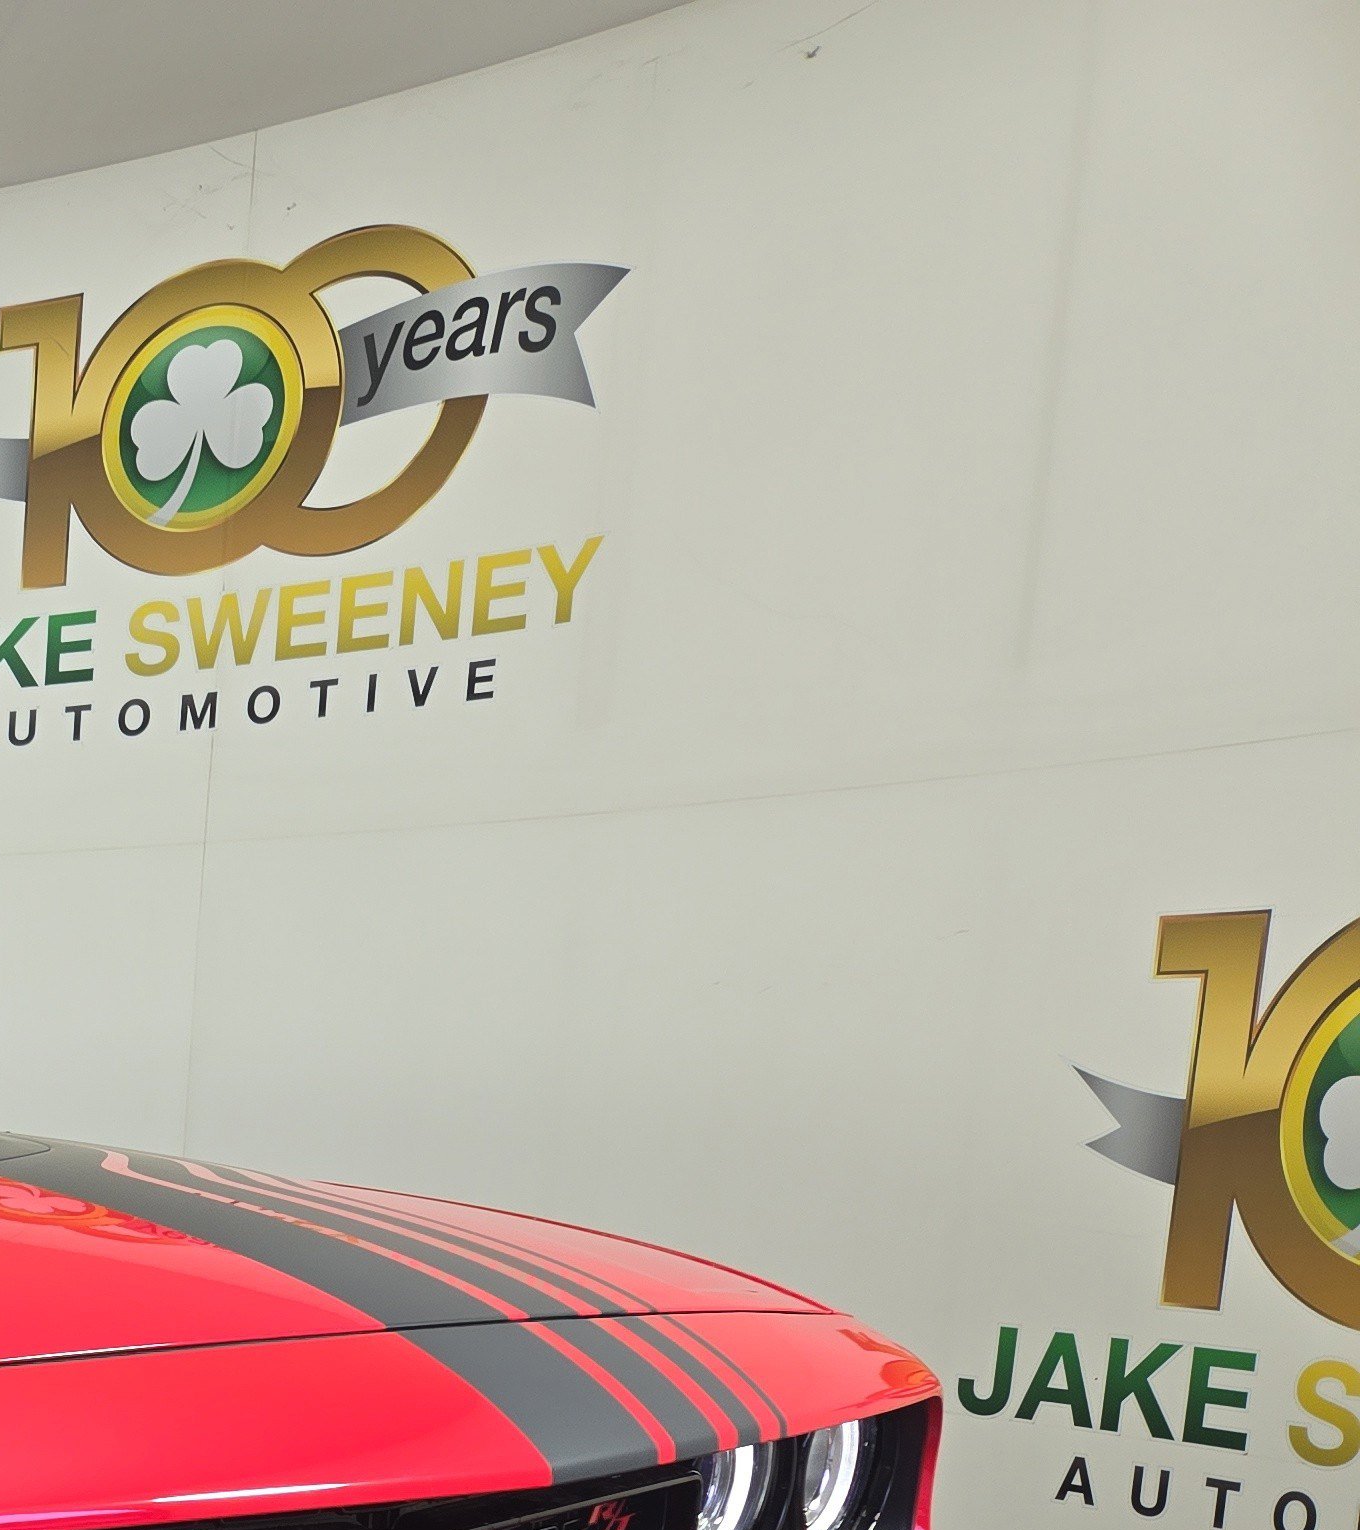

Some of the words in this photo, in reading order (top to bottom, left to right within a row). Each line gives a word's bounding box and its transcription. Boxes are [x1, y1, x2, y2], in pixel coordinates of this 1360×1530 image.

[356, 285, 563, 406] years
[125, 536, 606, 678] SWEENEY
[957, 1325, 1260, 1454] JAKE
